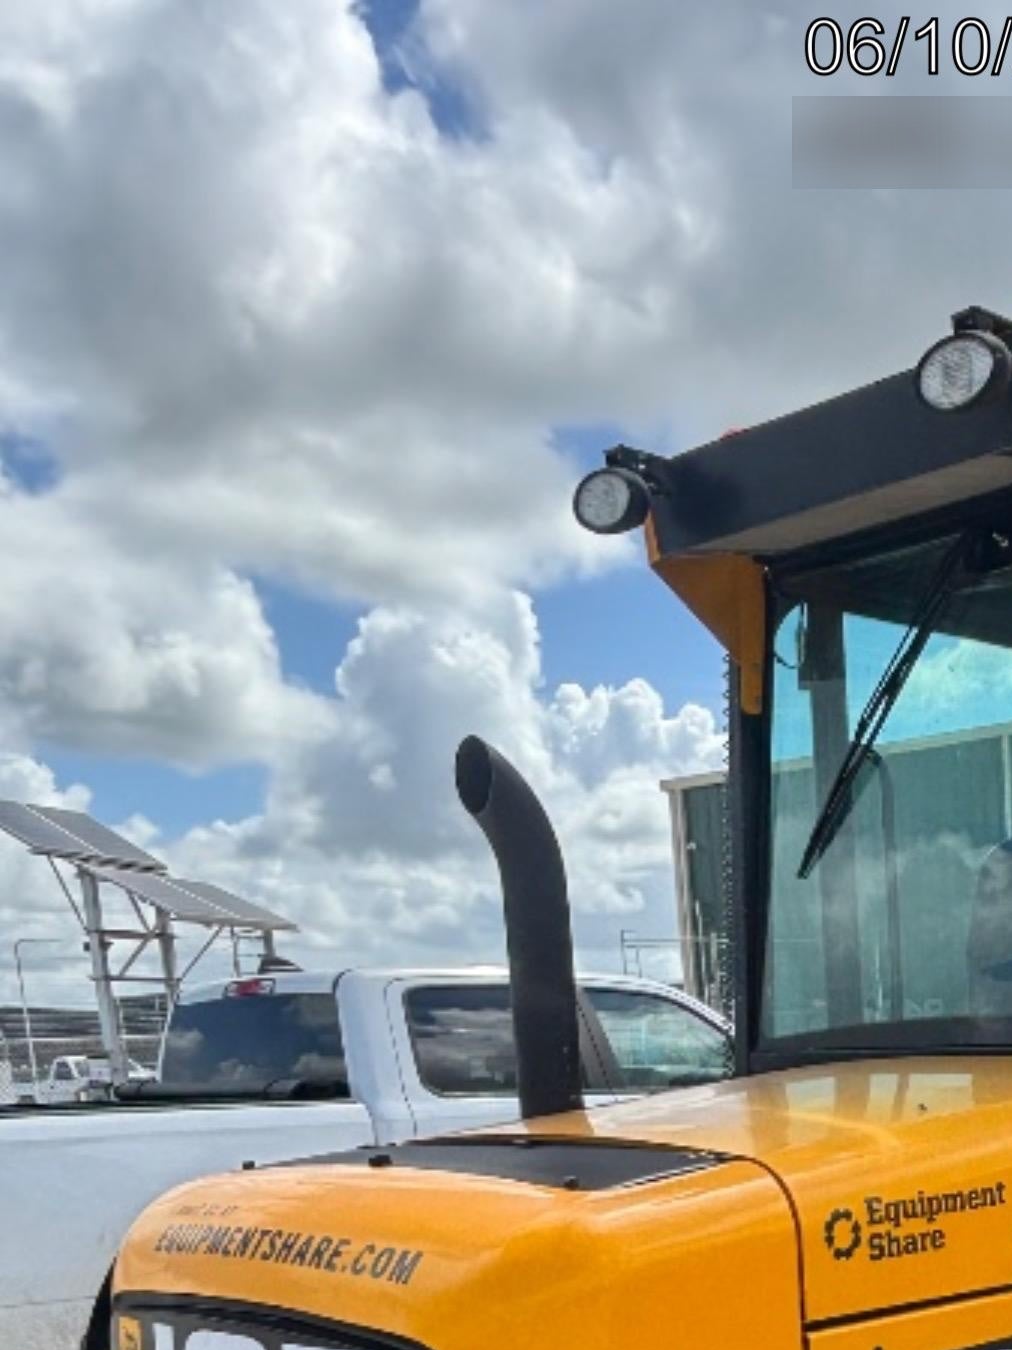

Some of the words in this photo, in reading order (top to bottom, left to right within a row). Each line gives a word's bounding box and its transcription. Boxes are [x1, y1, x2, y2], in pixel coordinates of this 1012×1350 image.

[864, 1182, 1006, 1227] Equipment
[155, 1223, 422, 1285] EQUIPMENTSHARE.COM
[869, 1229, 946, 1261] Share
